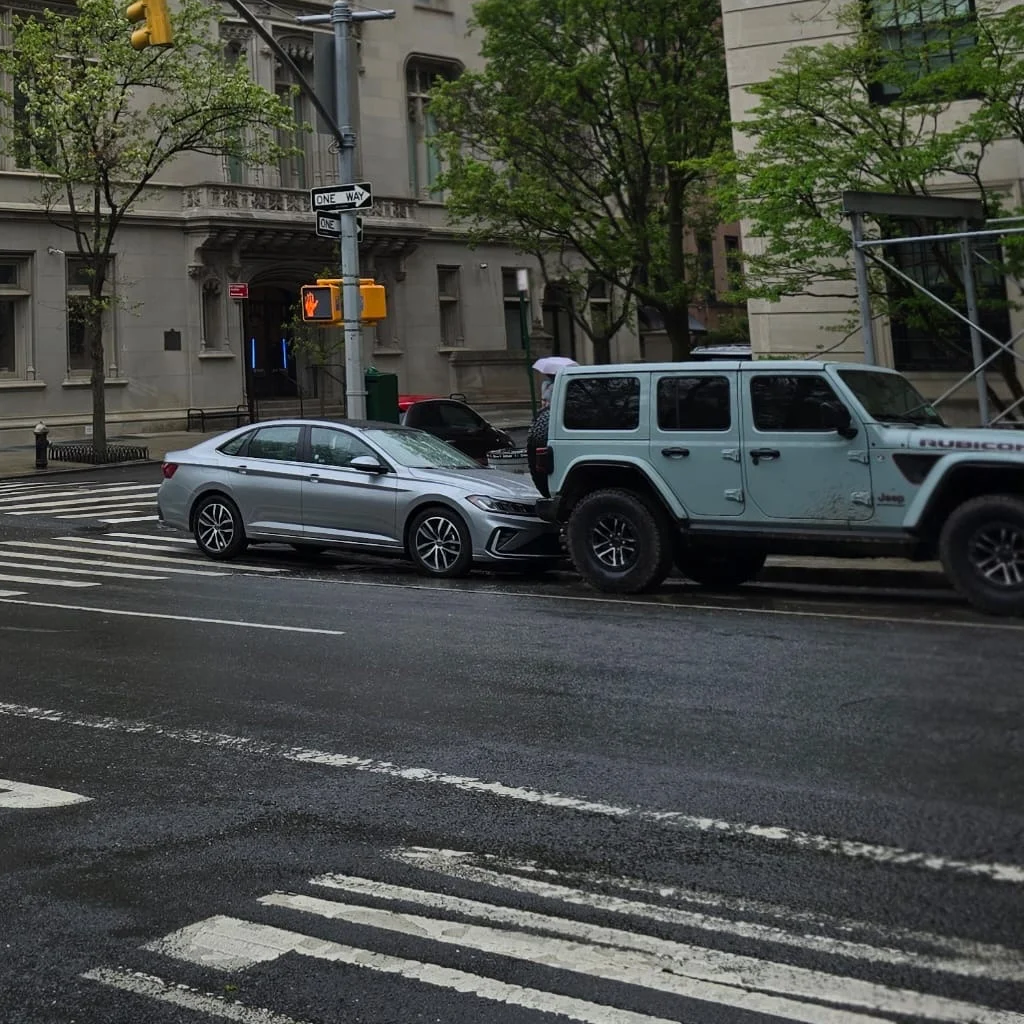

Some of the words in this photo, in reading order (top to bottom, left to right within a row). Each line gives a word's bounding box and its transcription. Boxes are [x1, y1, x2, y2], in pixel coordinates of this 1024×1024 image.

[316, 193, 336, 204] ONE
[346, 191, 364, 201] WAY
[320, 218, 335, 229] ONE
[878, 492, 905, 504] Jeep
